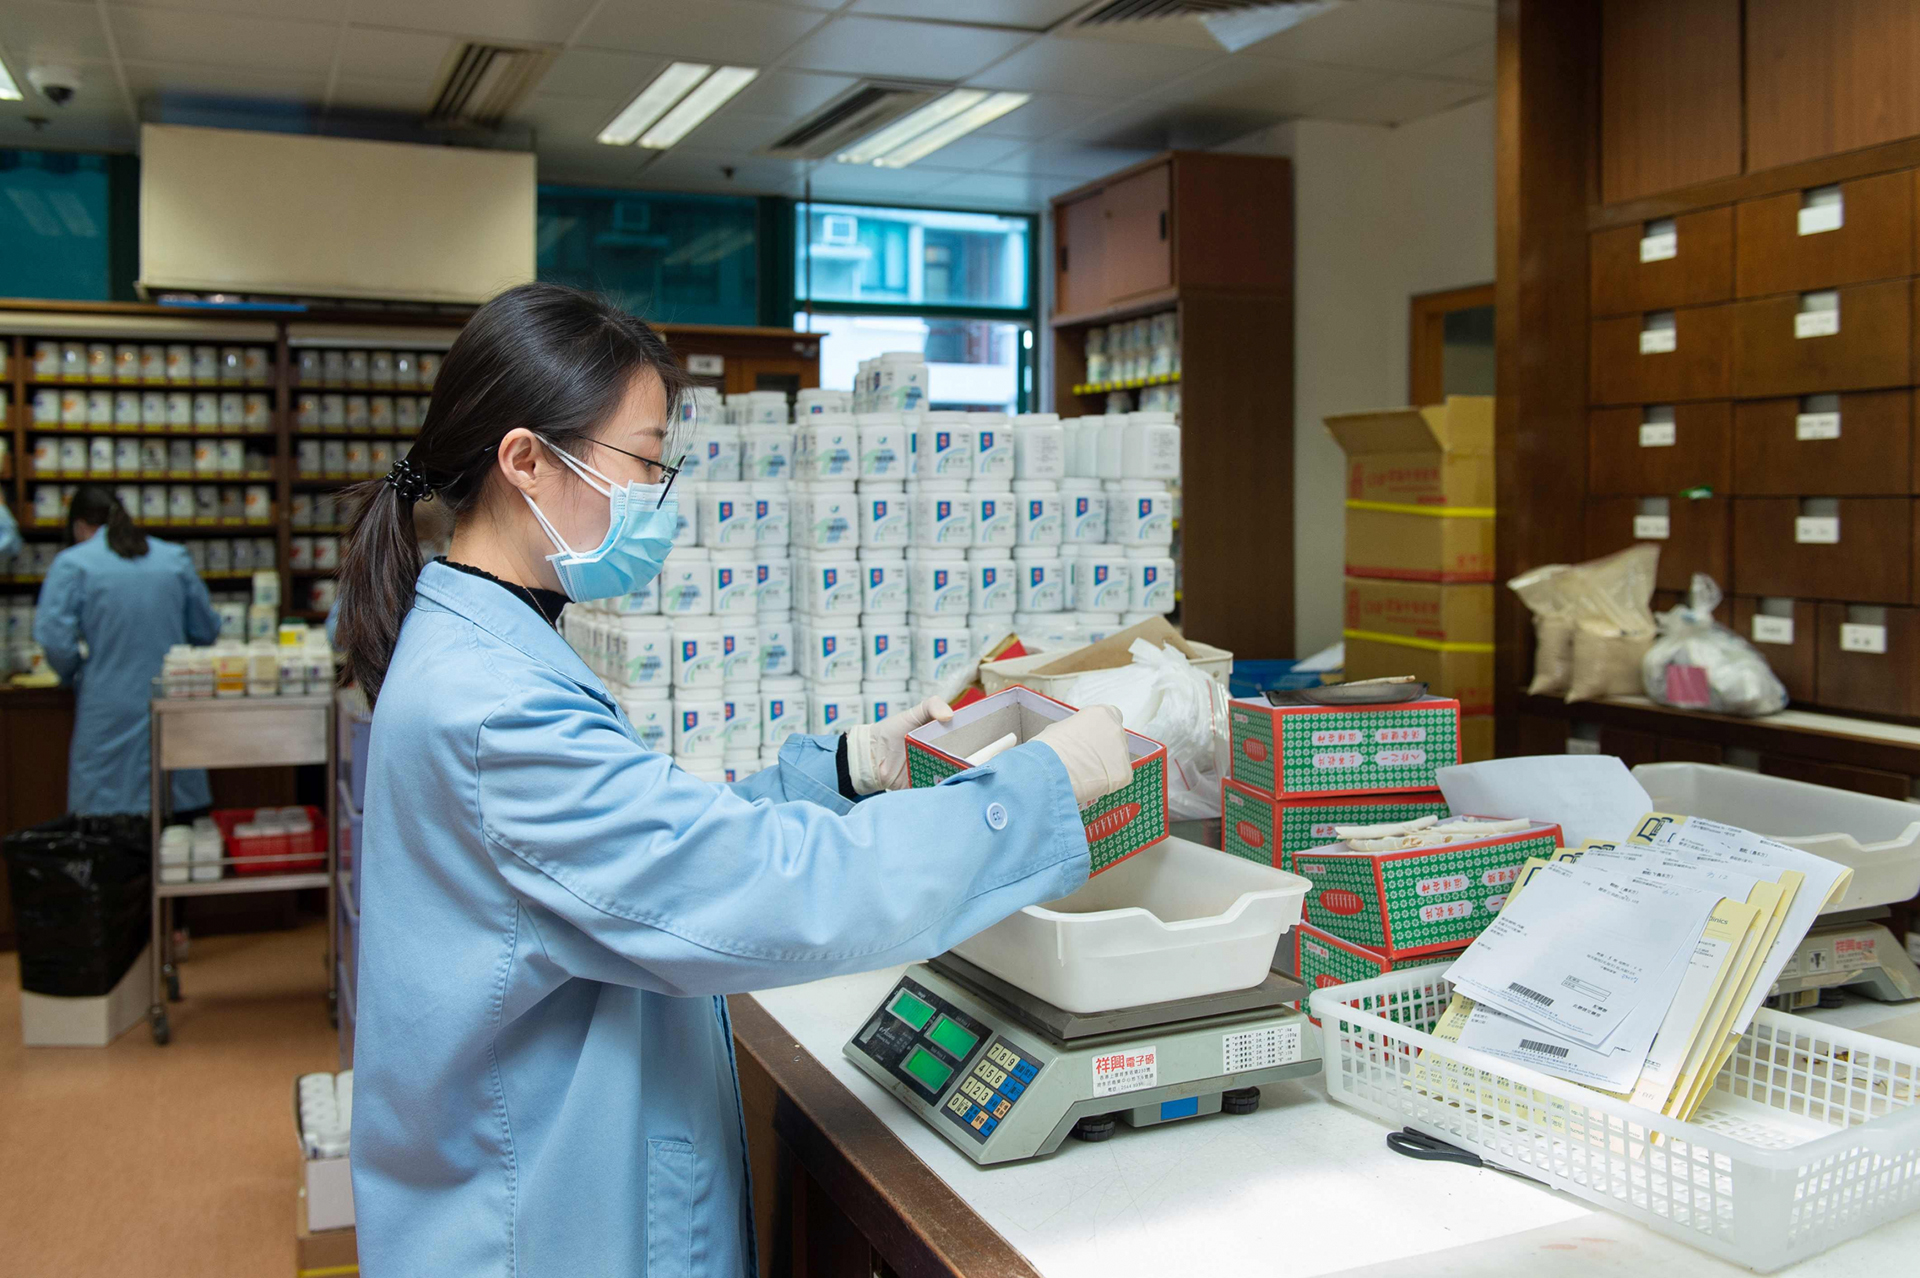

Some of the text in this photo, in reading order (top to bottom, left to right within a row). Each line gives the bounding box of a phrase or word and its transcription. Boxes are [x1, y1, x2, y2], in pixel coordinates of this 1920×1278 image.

[992, 1046, 999, 1055] 7
[1000, 1053, 1007, 1061] 8
[1008, 1058, 1016, 1067] 9
[1096, 1054, 1154, 1074] 祥興電子磅
[979, 1064, 986, 1073] 4
[986, 1069, 995, 1078] 5
[994, 1075, 1003, 1084] 6
[965, 1081, 989, 1101] 1 2 3
[951, 1097, 959, 1106] 0
